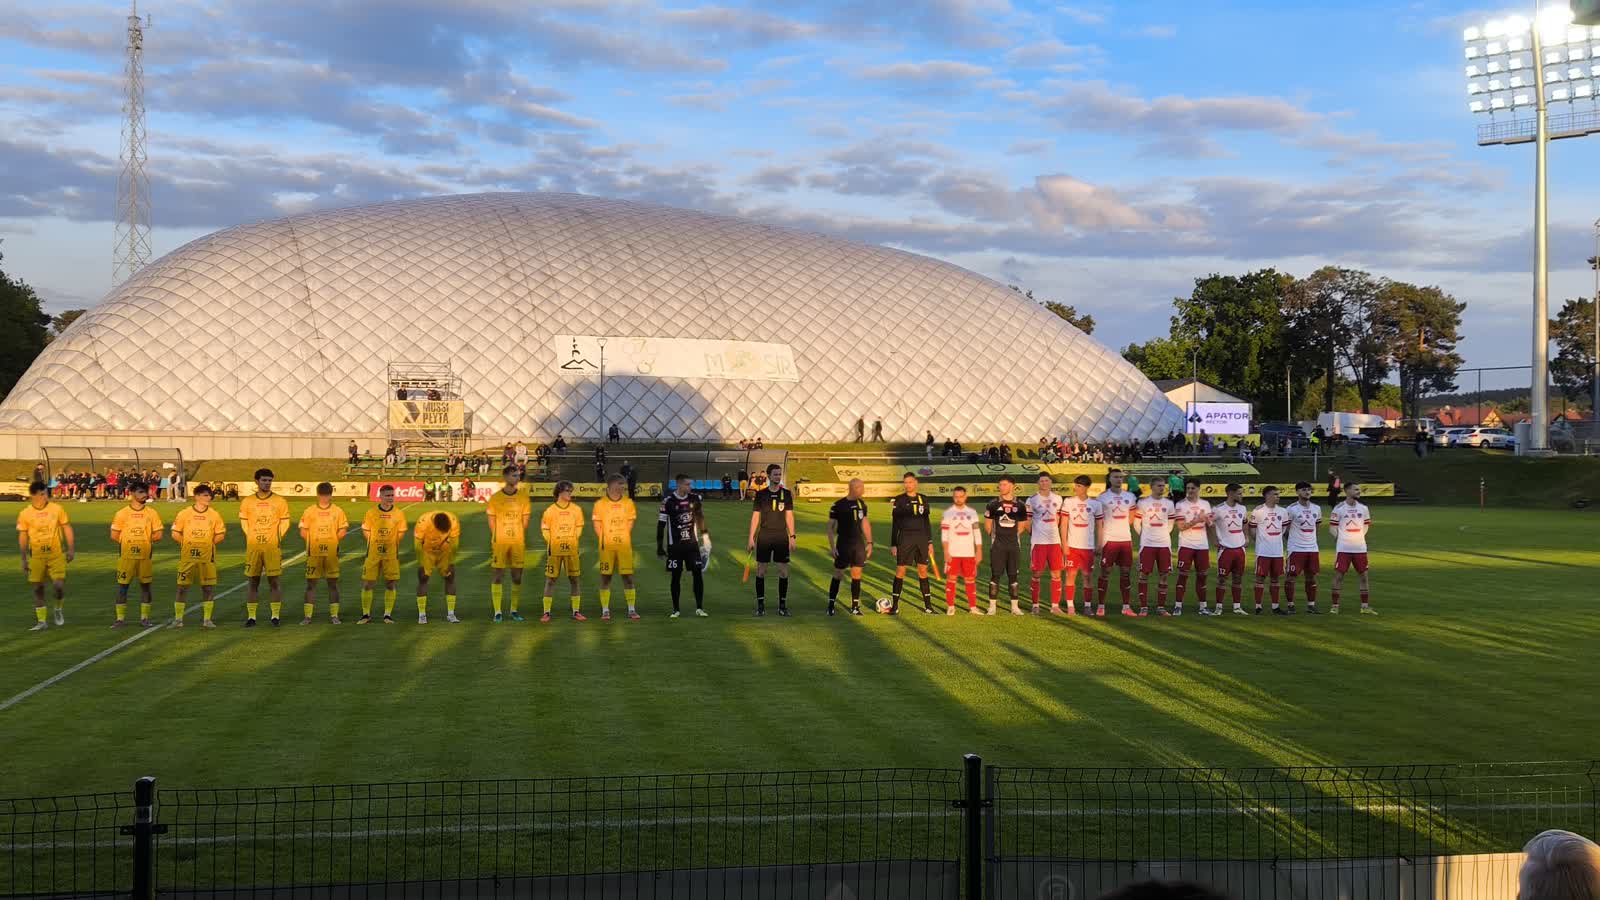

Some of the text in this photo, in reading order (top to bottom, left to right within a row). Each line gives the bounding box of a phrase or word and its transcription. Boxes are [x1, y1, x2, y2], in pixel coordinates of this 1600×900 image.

[1205, 412, 1249, 420] APATOR
[376, 486, 424, 498] tclic
[668, 560, 678, 568] 26
